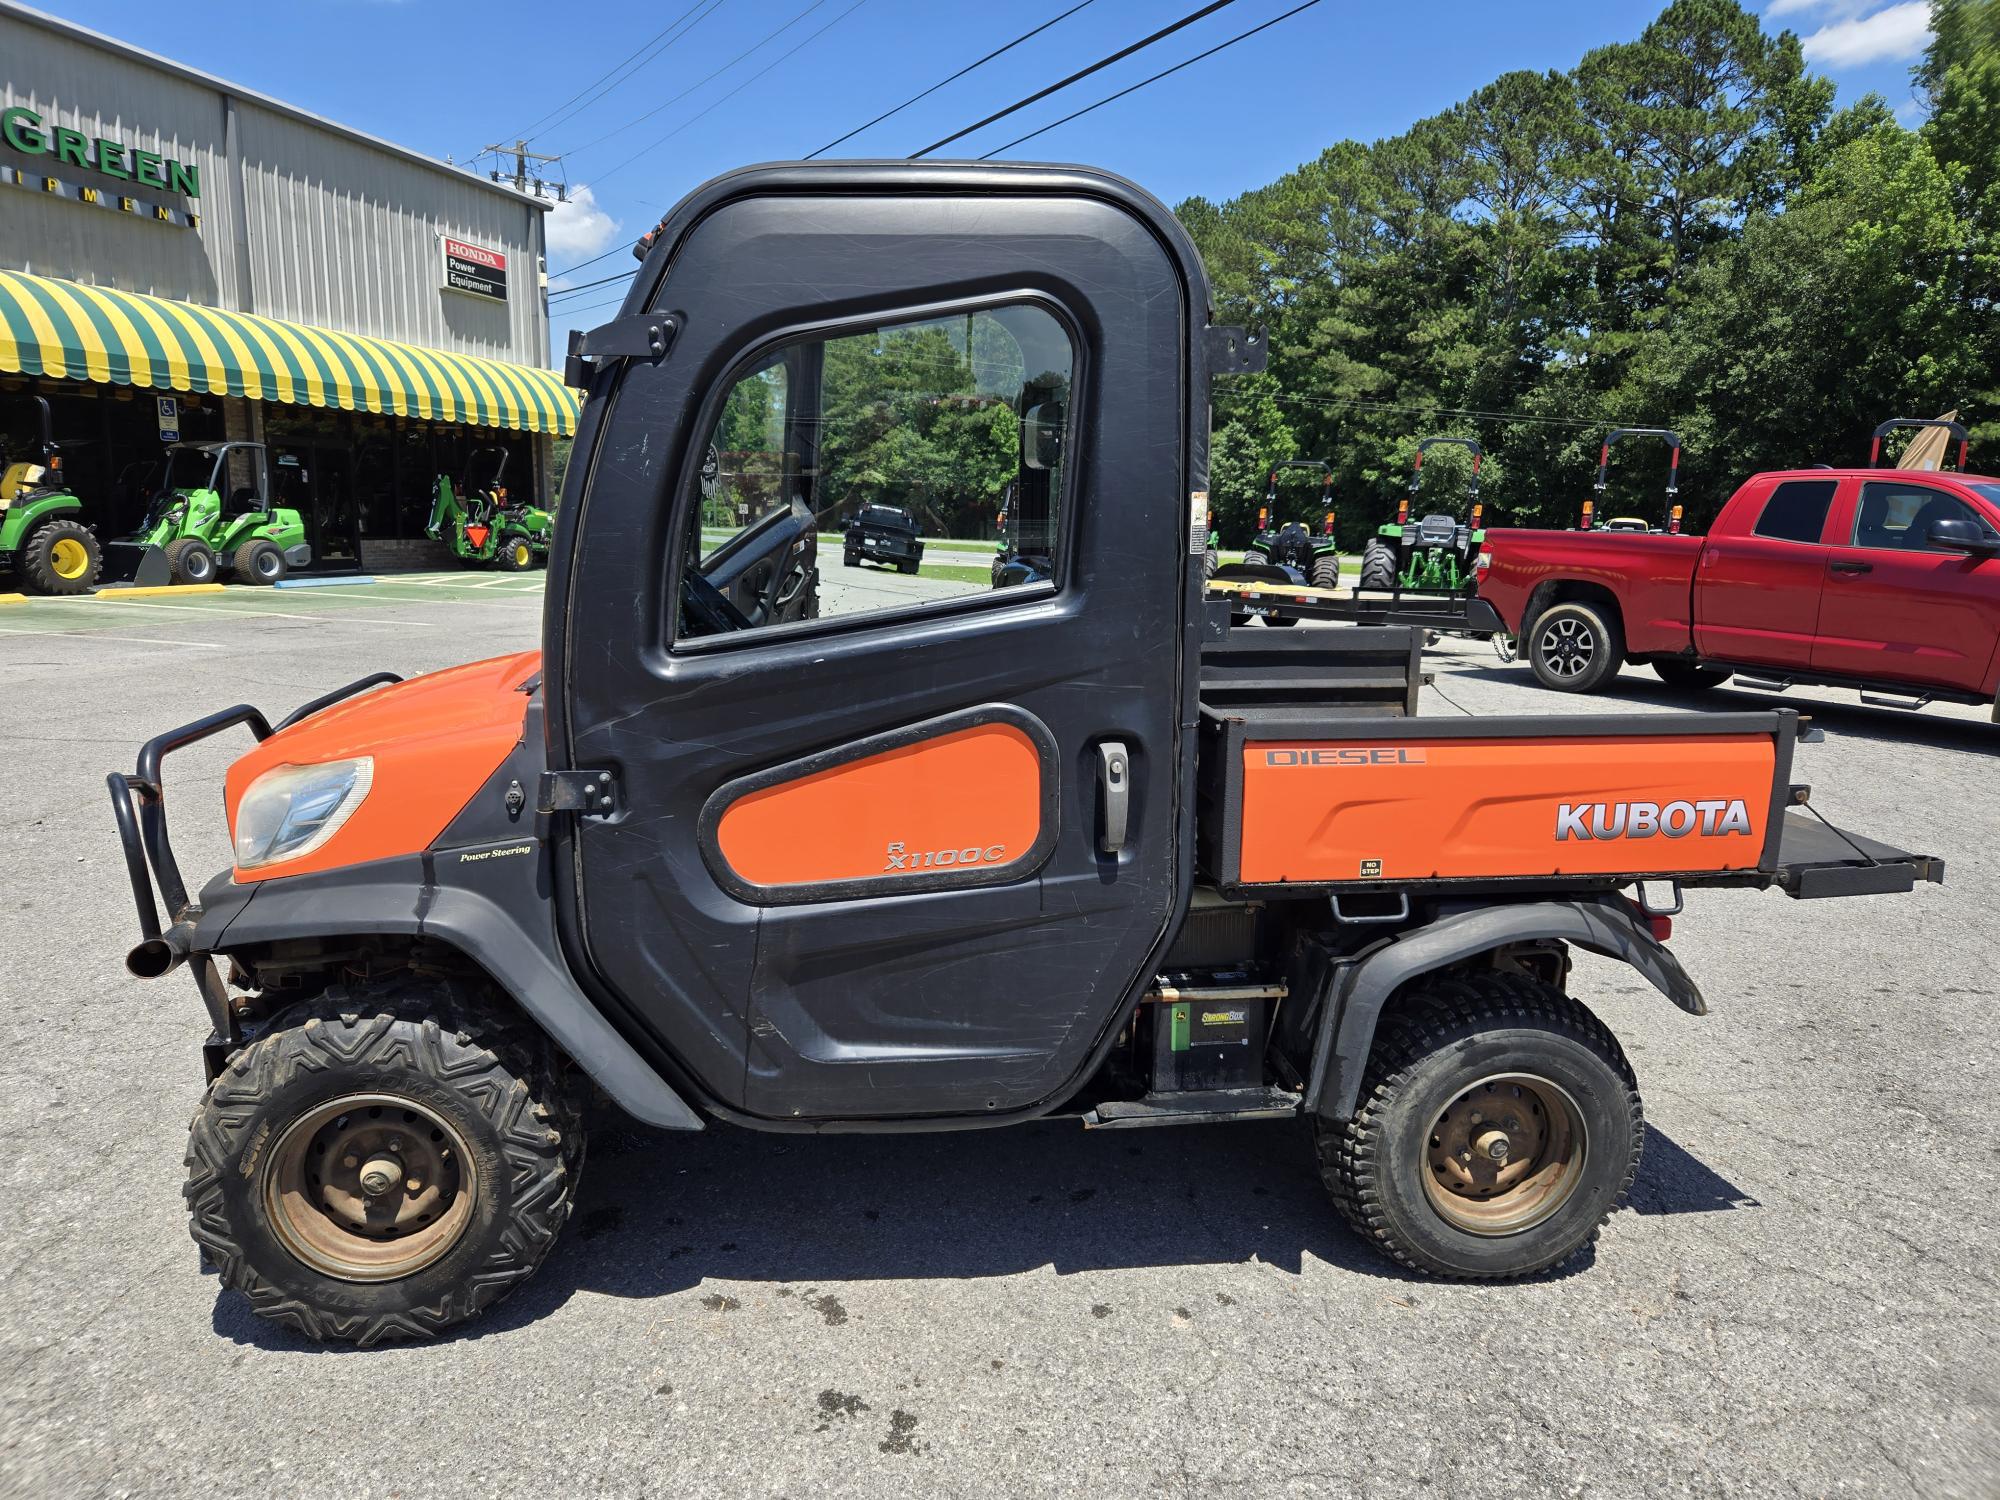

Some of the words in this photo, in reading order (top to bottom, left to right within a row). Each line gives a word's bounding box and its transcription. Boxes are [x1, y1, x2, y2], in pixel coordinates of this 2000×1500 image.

[3, 106, 200, 198] GREEN
[448, 241, 496, 265] HONDA
[450, 258, 475, 274] Power
[450, 273, 492, 293] Equipment
[1266, 749, 1425, 766] DIESEL
[1555, 799, 1752, 841] KUBOTA
[460, 852, 490, 862] Power
[491, 845, 531, 858] Steering
